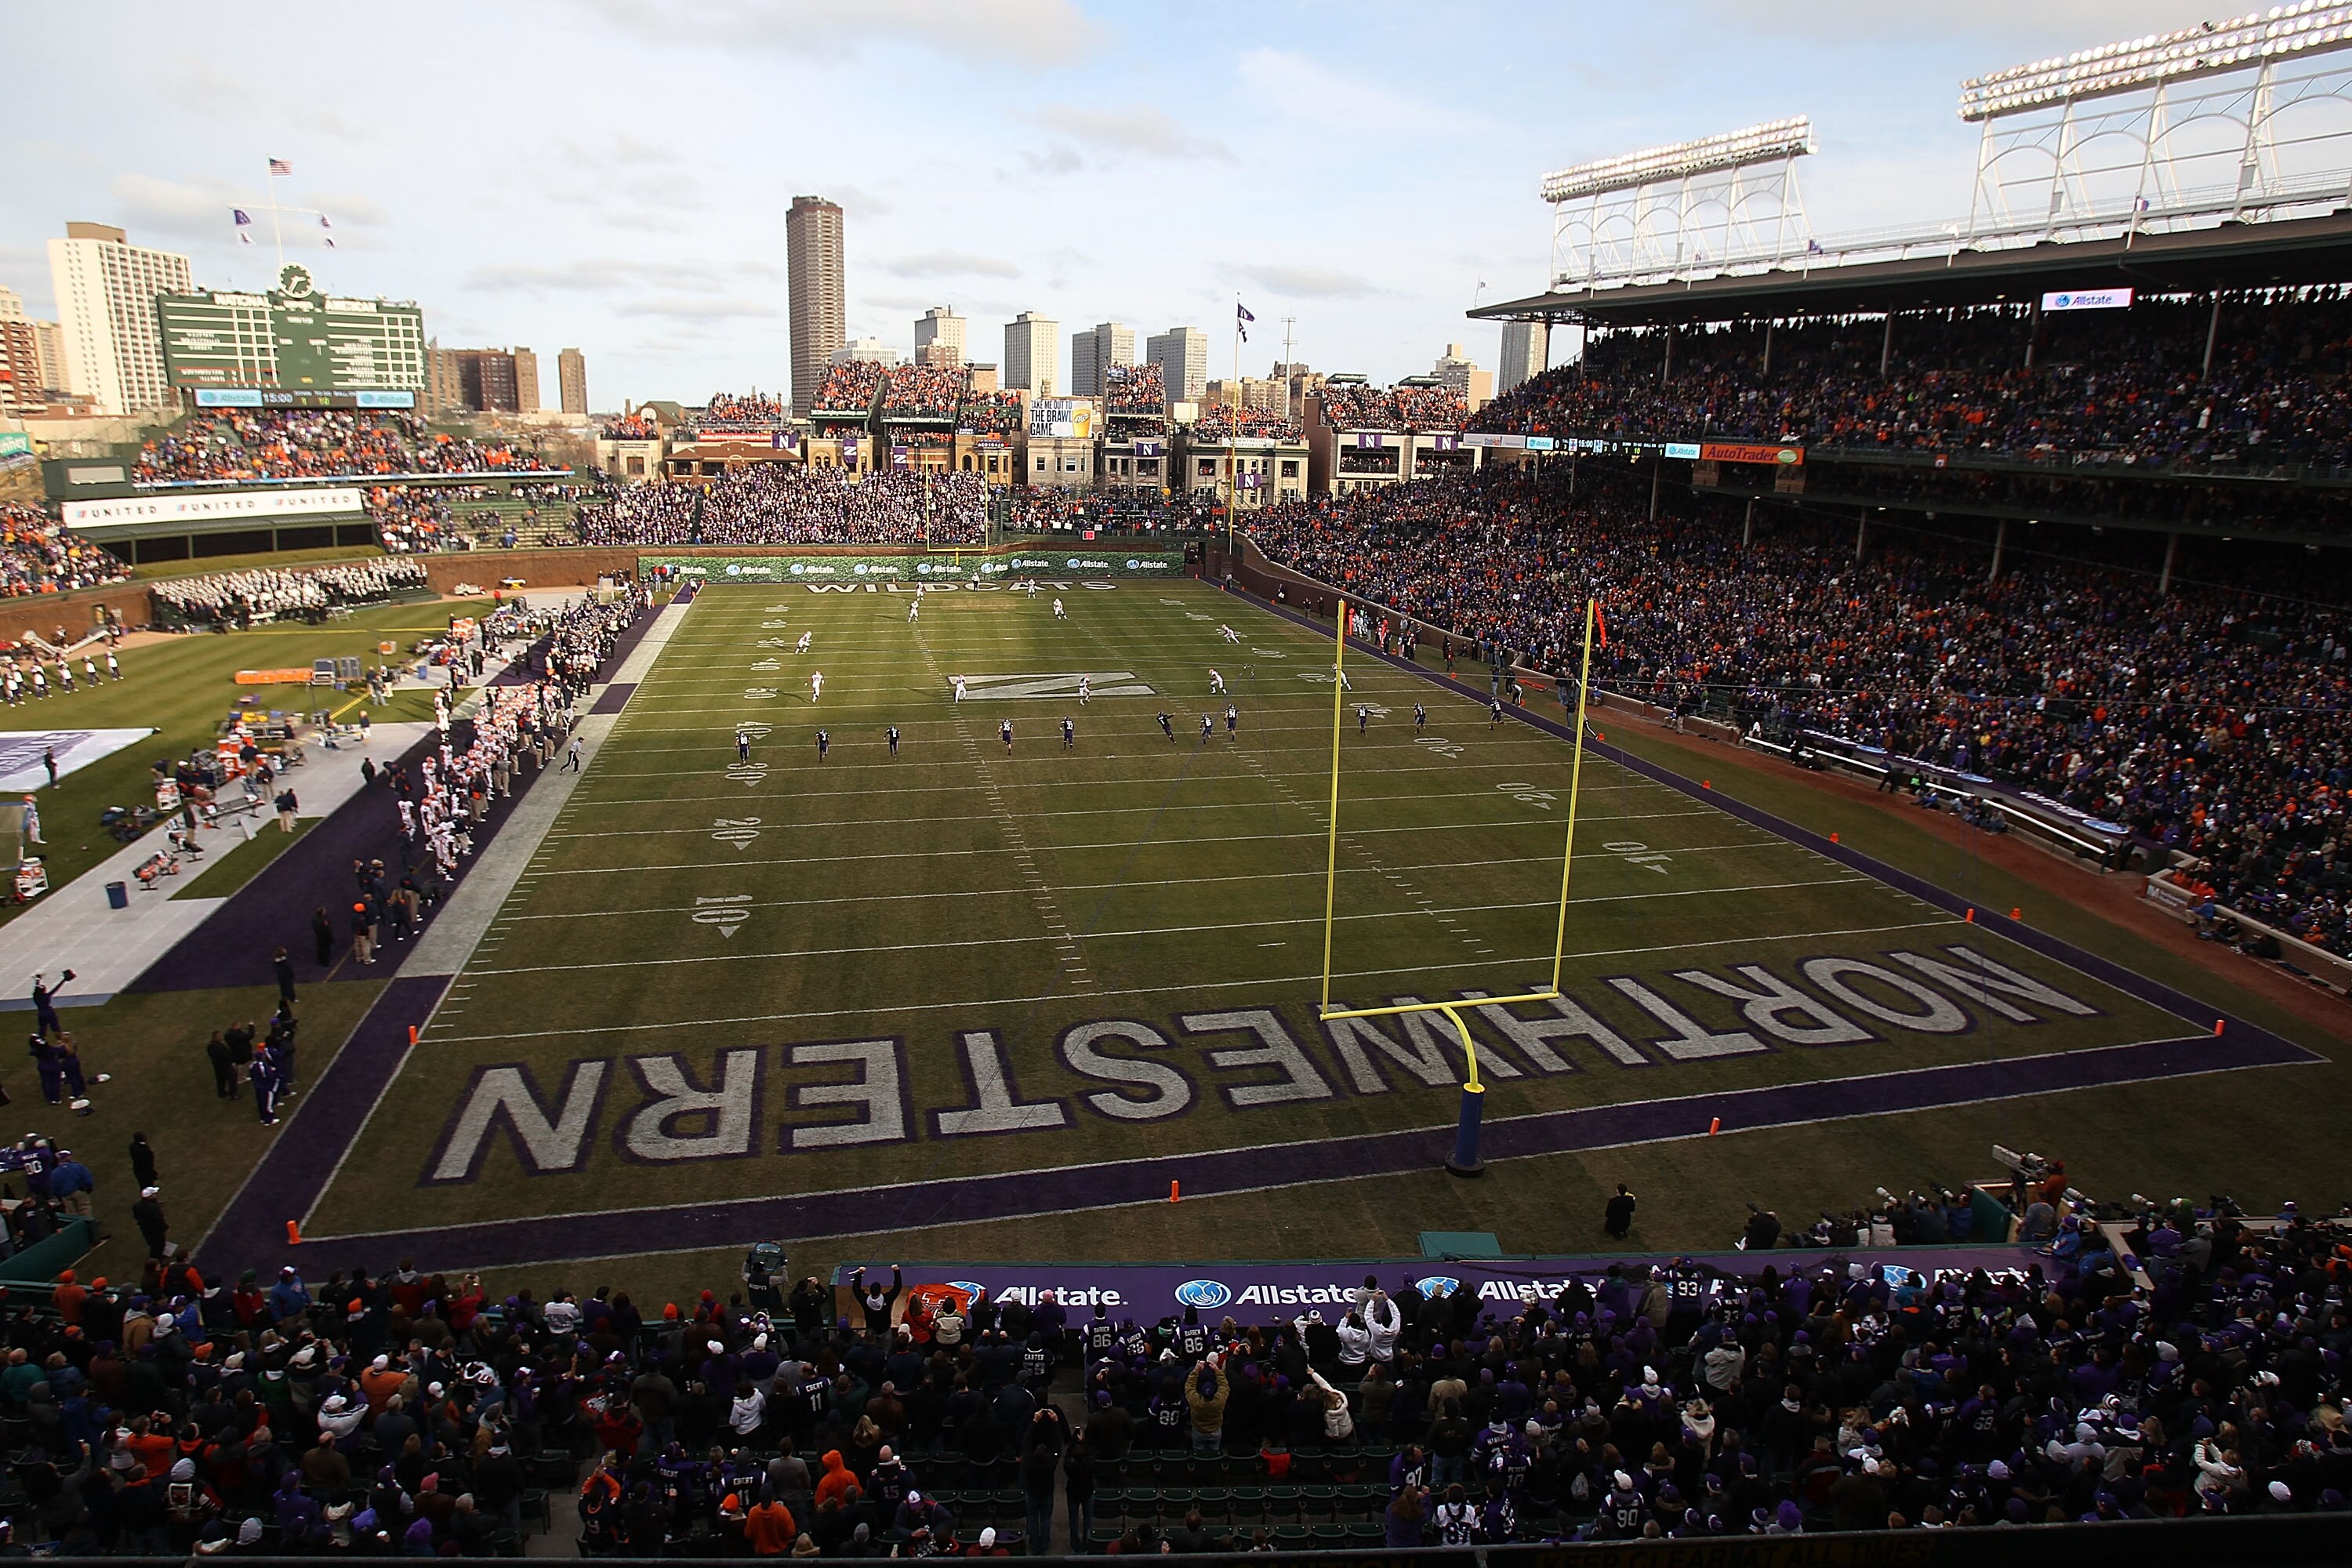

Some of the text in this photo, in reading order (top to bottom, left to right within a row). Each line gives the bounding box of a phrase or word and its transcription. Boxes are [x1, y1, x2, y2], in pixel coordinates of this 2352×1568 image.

[213, 293, 272, 307] NATIONAL
[2071, 295, 2113, 307] Allstate
[1031, 401, 1043, 409] TAKE
[1044, 401, 1052, 409] ME
[1054, 401, 1065, 409] OUT
[1030, 409, 1073, 423] THE BRAWL
[1030, 423, 1055, 436] GAME.
[779, 435, 789, 448] N
[1366, 434, 1375, 448] N
[1442, 437, 1451, 450] N
[844, 446, 857, 456] N
[1143, 444, 1152, 455] N
[894, 455, 906, 463] N
[1245, 475, 1254, 487] N
[191, 500, 254, 512] UNITED
[289, 495, 350, 506] UNITED
[92, 506, 157, 518] UNITED
[740, 566, 771, 575] Allstate
[804, 565, 835, 574] Allstate
[868, 565, 898, 574] Allstate
[931, 564, 963, 573] Allstate
[1138, 561, 1167, 569] Allstate
[805, 581, 1117, 593] WILDCATS
[724, 763, 768, 780] 30
[1496, 782, 1558, 801] 20
[711, 817, 761, 840] 20
[1602, 841, 1672, 863] 10
[691, 895, 753, 923] 10
[431, 946, 2098, 1182] NORTHWESTERN
[1236, 1283, 1357, 1305] Allstate
[1678, 1281, 1698, 1297] 93
[1093, 1334, 1112, 1348] 86
[1184, 1337, 1203, 1354] 86
[810, 1392, 822, 1412] 11
[1159, 1410, 1180, 1425] 80
[733, 1476, 754, 1486] EBERT
[1405, 1466, 1423, 1487] 97
[1617, 1509, 1639, 1528] 90
